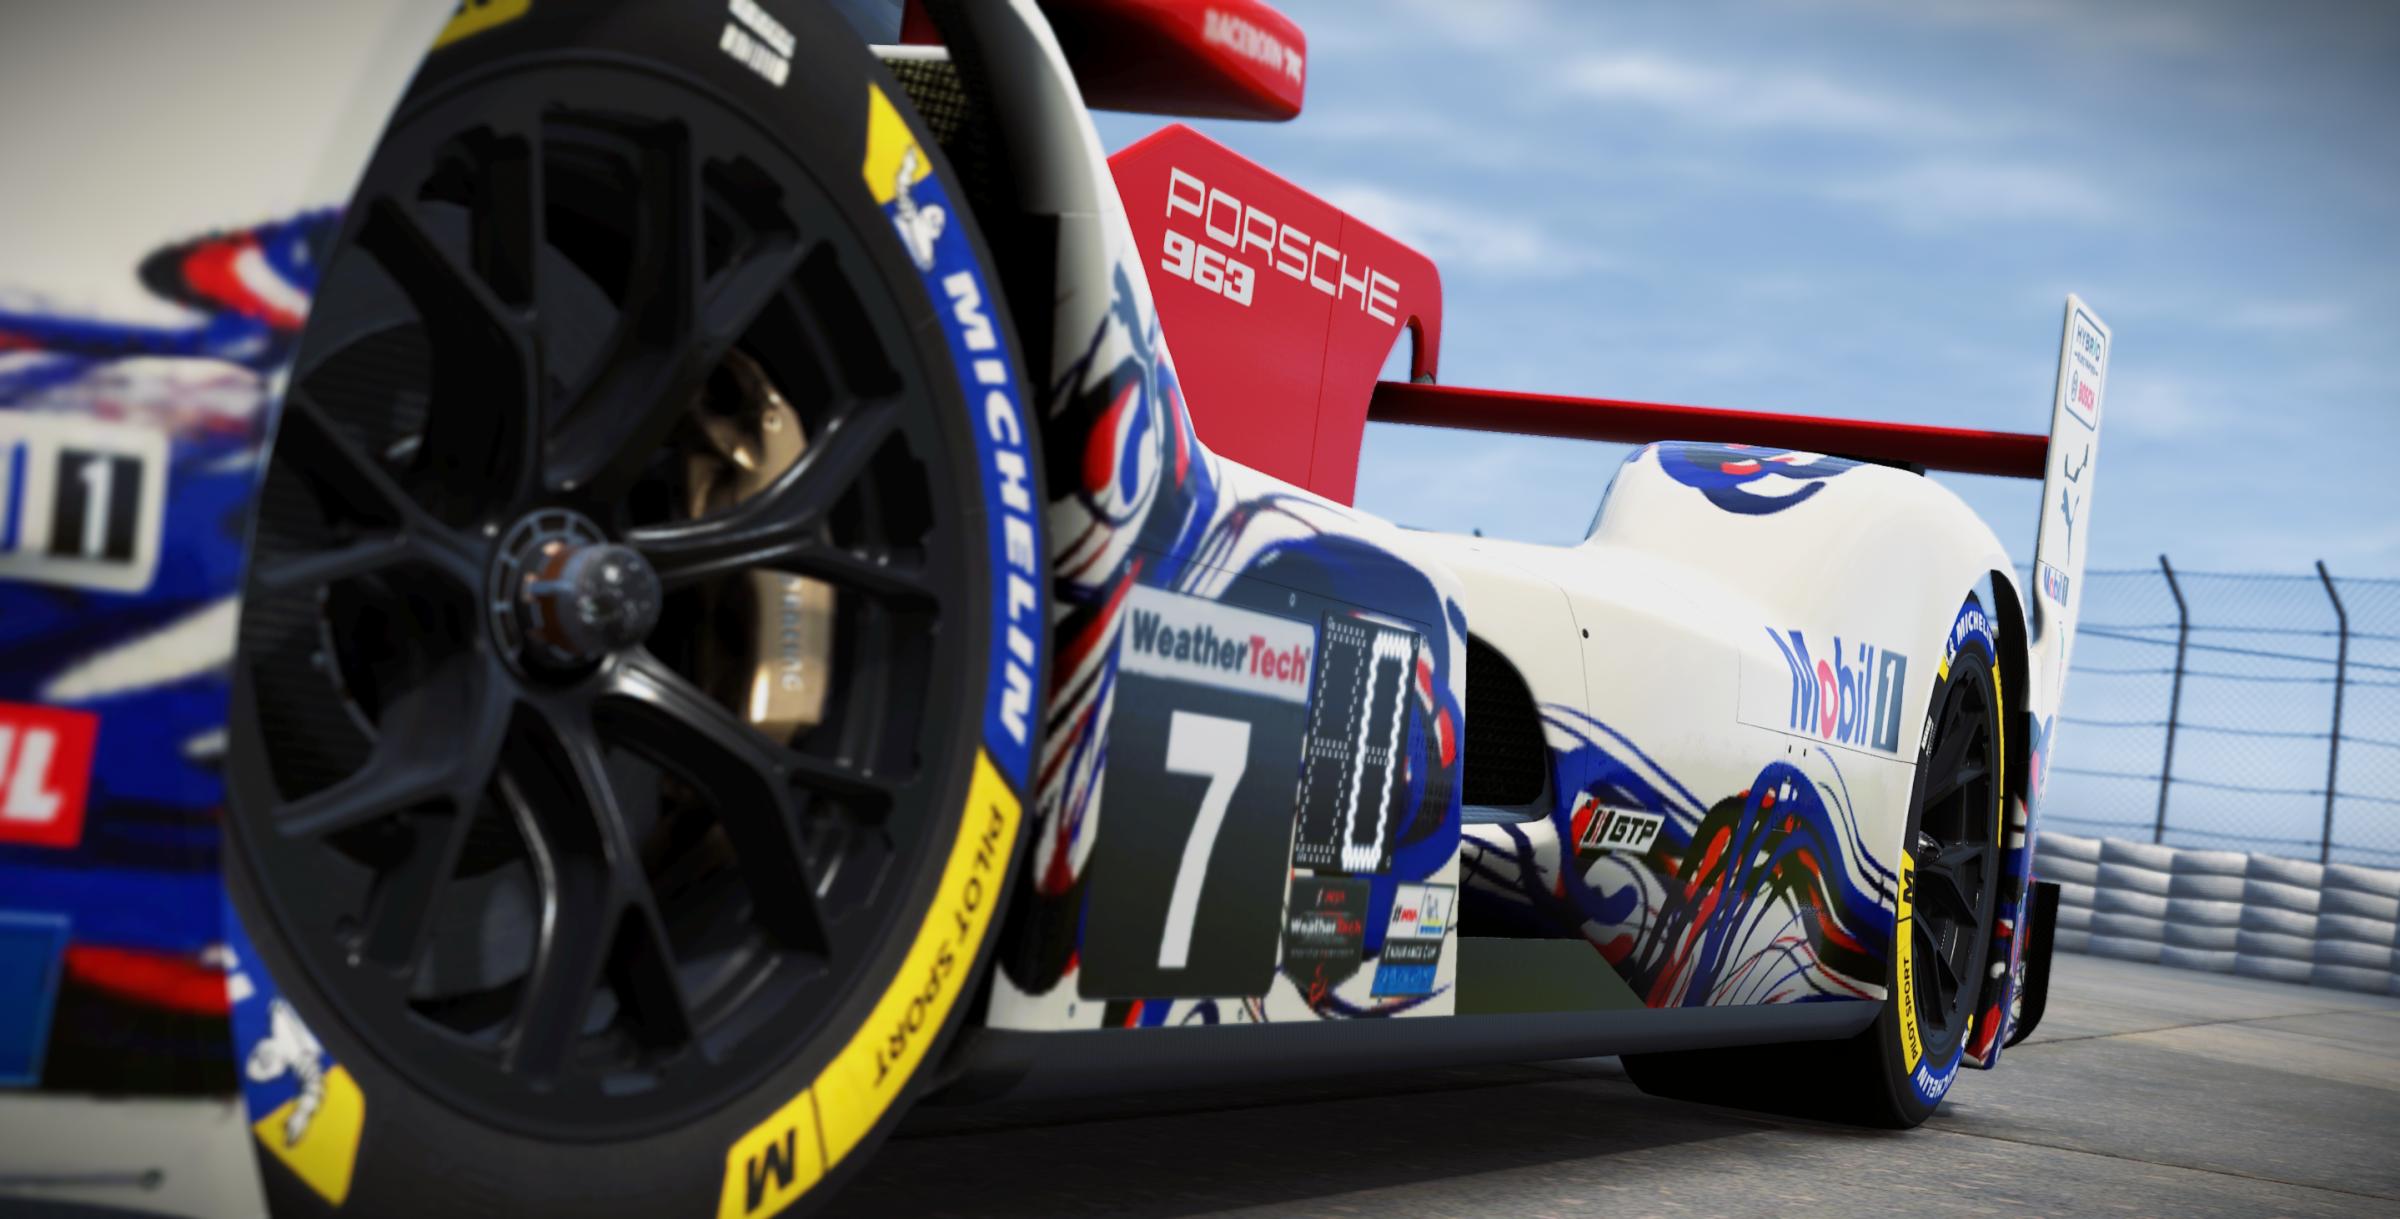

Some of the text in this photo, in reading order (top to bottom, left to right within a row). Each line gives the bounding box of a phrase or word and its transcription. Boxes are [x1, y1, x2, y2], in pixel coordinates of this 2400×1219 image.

[1161, 229, 1255, 307] 963
[1166, 167, 1400, 326] PORSCHE
[943, 271, 1036, 746] MICHELIN
[1956, 611, 1994, 654] MICHELIN
[1765, 626, 1874, 747] Mobil
[1157, 710, 1252, 968] 7
[1608, 815, 1659, 845] GTP
[1902, 868, 1914, 904] M
[872, 804, 1005, 1089] PILOT SPORT
[1903, 957, 1919, 1060] PILOT SPORT
[743, 1126, 798, 1218] M
